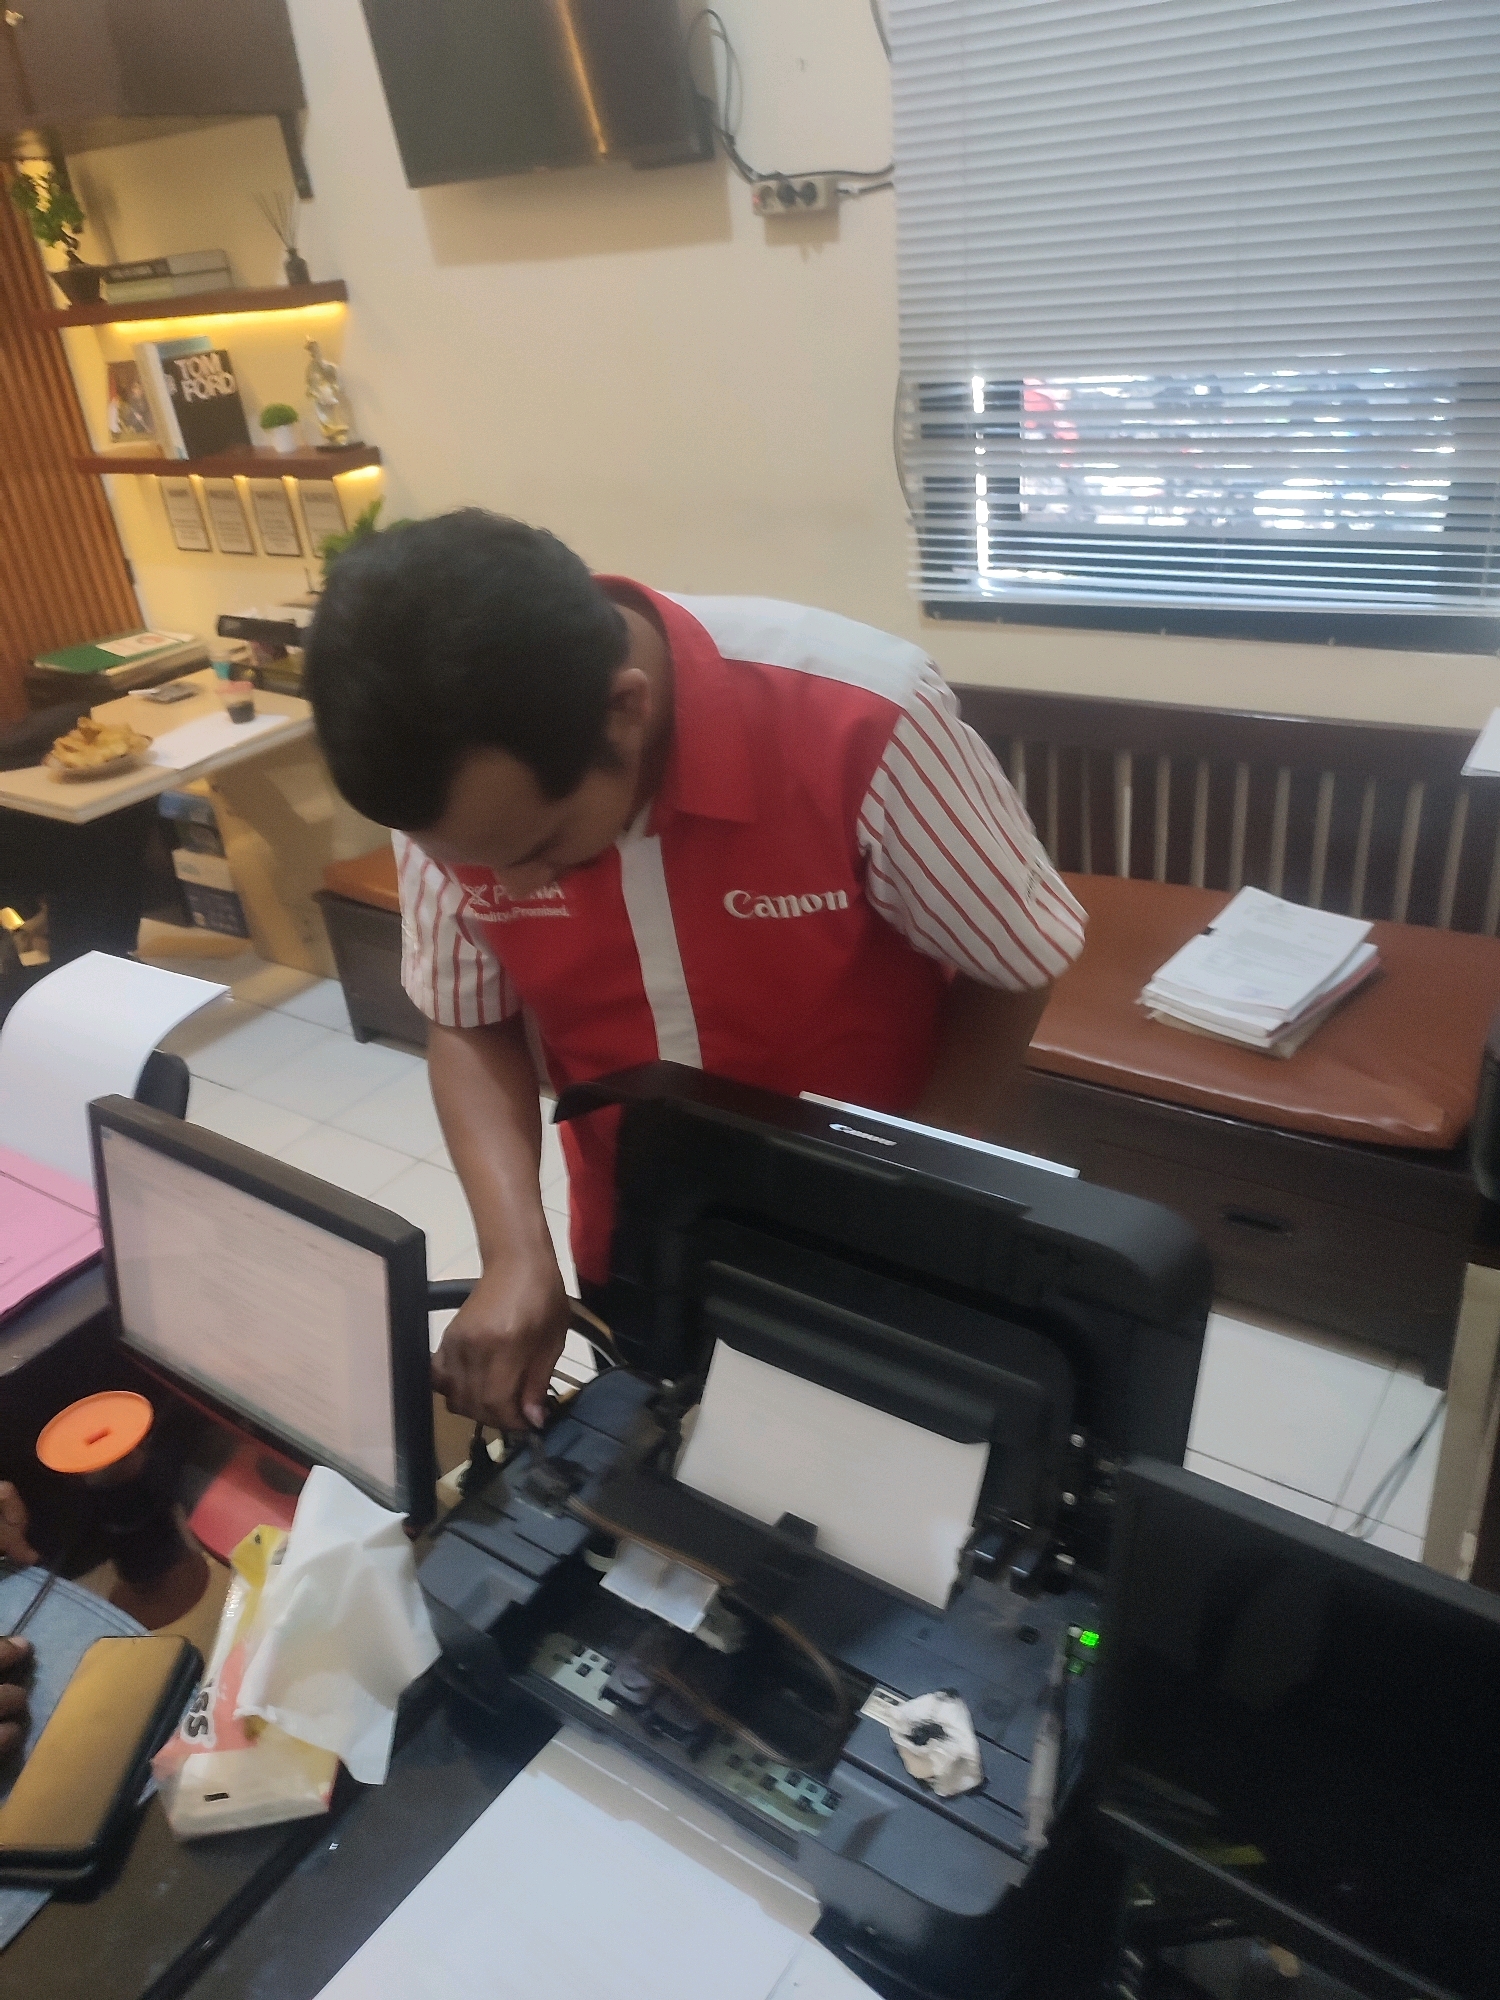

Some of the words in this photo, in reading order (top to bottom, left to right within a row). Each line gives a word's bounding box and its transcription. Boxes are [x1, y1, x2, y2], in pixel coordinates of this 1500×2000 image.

[174, 353, 223, 382] TOM
[181, 372, 236, 403] FORD
[723, 889, 849, 919] Canon
